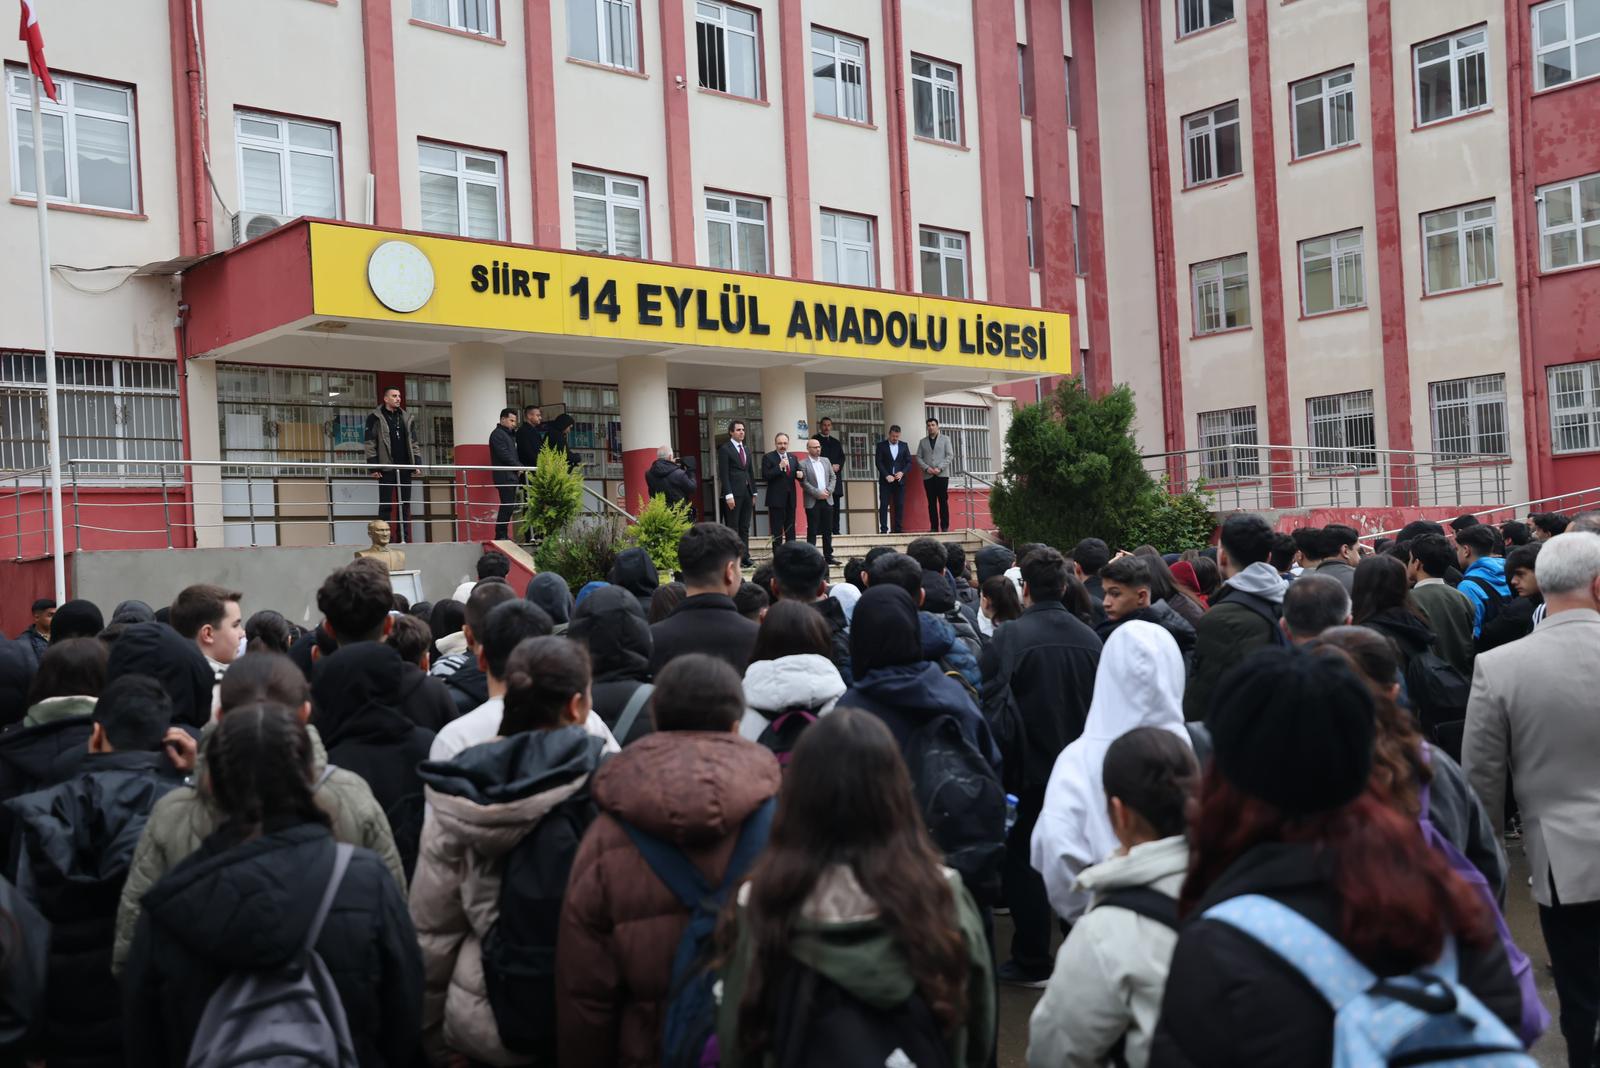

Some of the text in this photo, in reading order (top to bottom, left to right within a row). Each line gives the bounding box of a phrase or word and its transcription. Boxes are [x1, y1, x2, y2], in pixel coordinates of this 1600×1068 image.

[470, 261, 1047, 361] SİİRT 14 EYLÜL ANADOLU LİSESİ
